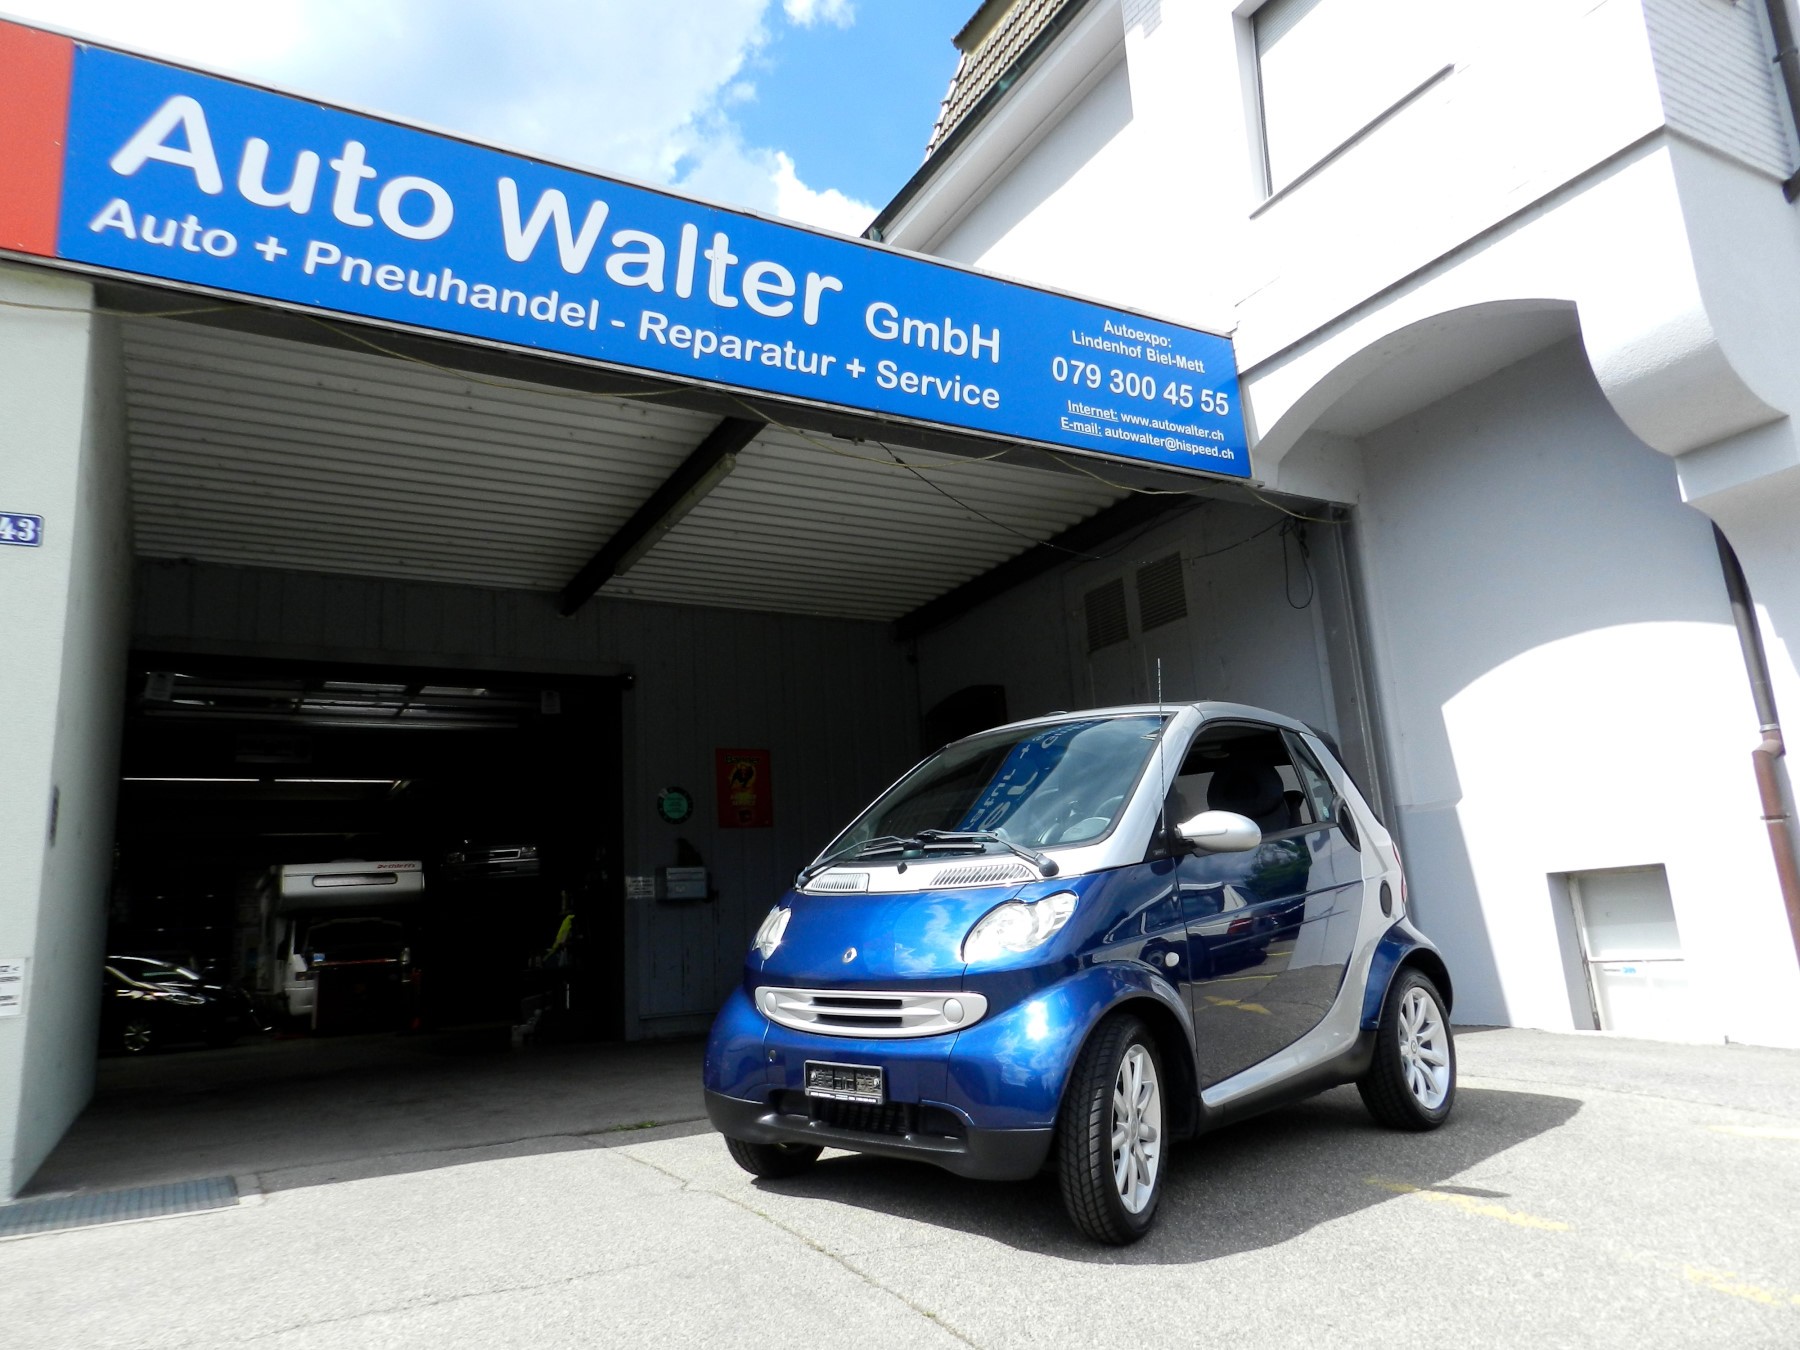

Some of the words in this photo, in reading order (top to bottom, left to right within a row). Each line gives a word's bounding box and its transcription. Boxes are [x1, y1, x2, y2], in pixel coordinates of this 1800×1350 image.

[110, 95, 454, 240] Auto
[498, 177, 843, 326] Walter
[865, 302, 1000, 363] GmbH
[90, 199, 237, 257] Auto
[255, 237, 287, 262] +
[304, 241, 600, 331] Pneuhandel
[639, 311, 837, 376] Reparatur
[846, 358, 866, 379] +
[876, 360, 1000, 409] Service
[1072, 330, 1142, 359] Lindenhof
[1146, 348, 1206, 374] Biel-Mett
[1104, 320, 1172, 348] Autoexpo:
[1052, 356, 1102, 389] 079
[1109, 369, 1157, 400] 300
[1163, 381, 1194, 408] 45
[1200, 389, 1229, 416] 55
[1060, 417, 1103, 437] E-mail:
[1104, 427, 1235, 460] autowalter@hispeed.ch
[1067, 400, 1119, 422] Internet:
[1121, 413, 1225, 441] www.autowalter.ch
